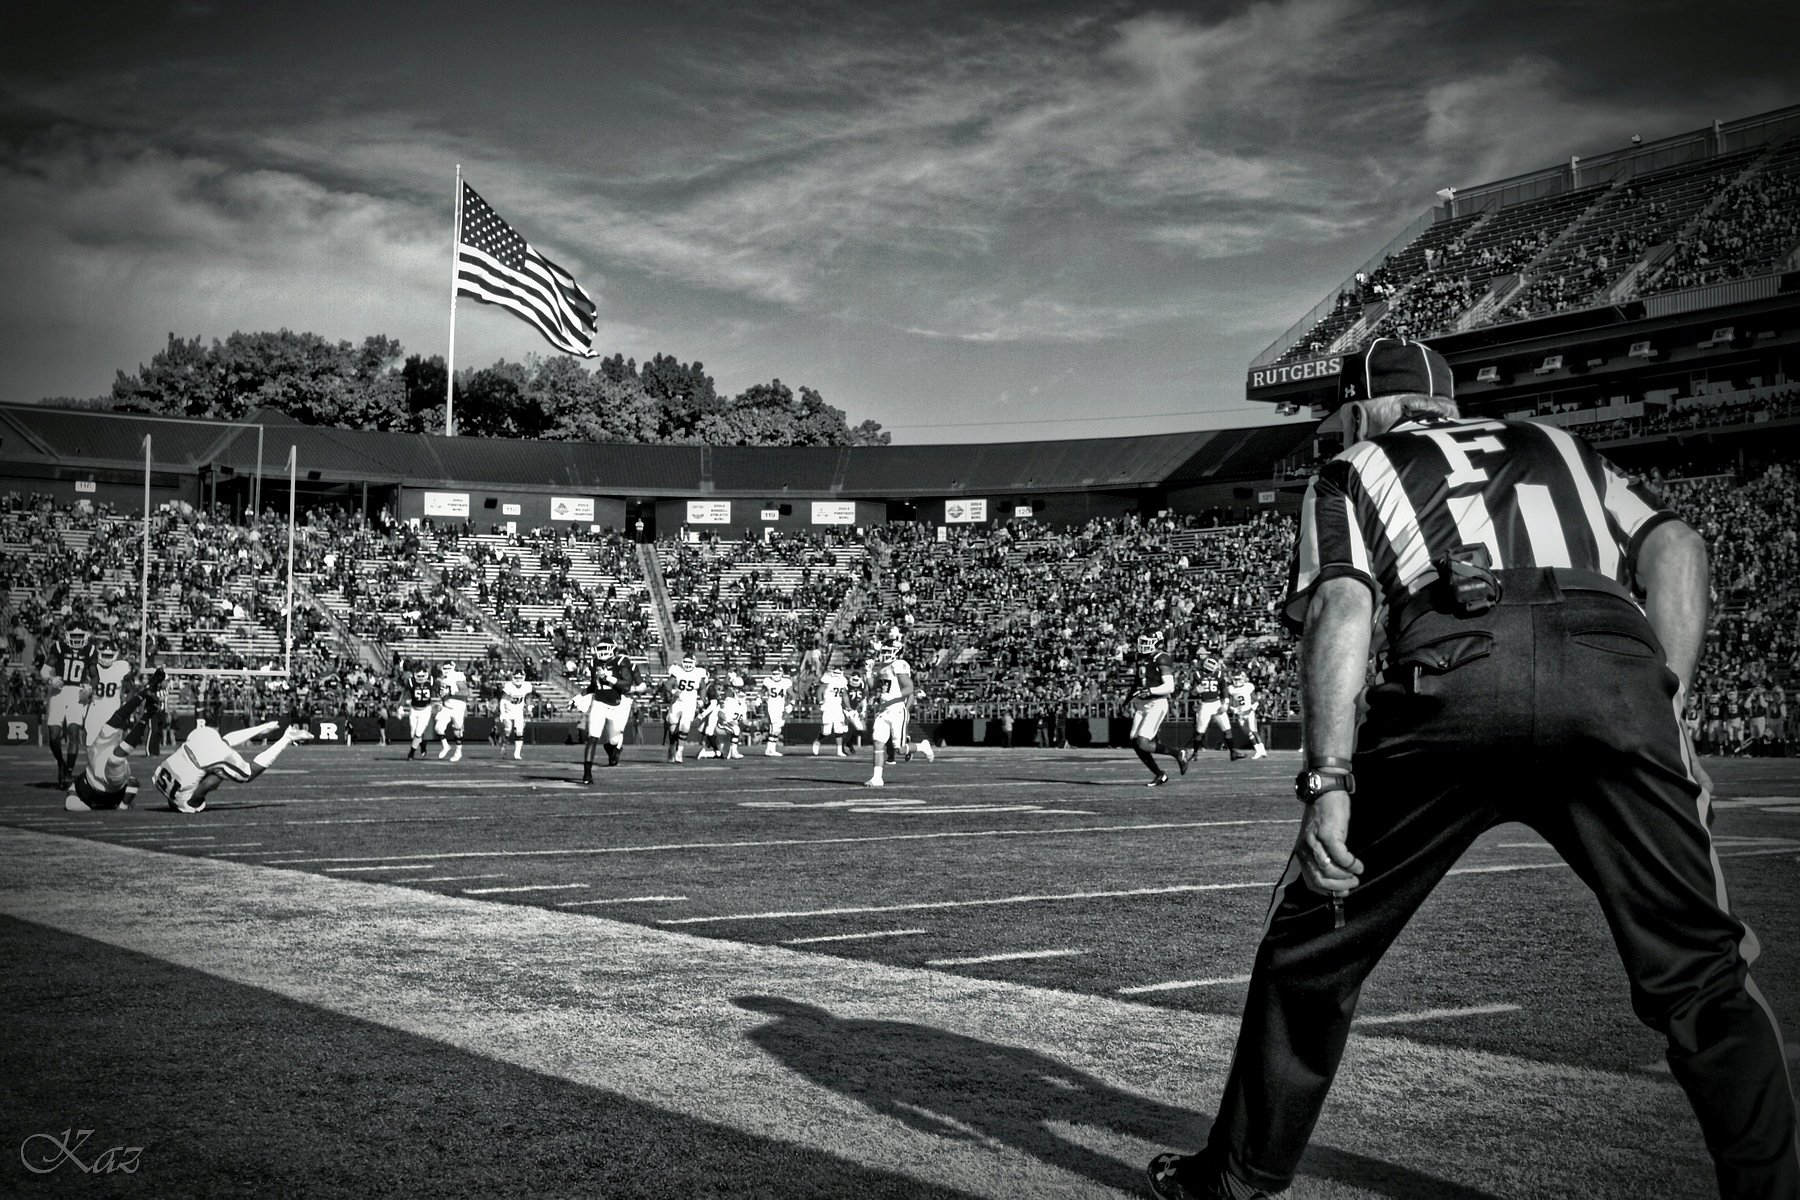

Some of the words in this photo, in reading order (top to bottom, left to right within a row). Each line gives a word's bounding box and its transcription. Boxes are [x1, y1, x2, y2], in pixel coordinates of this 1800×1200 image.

[1253, 357, 1341, 387] RUTGERS
[63, 658, 85, 682] 10
[96, 682, 117, 698] 88
[678, 679, 695, 692] 65
[770, 687, 785, 699] 54
[414, 689, 431, 701] 53
[7, 721, 29, 740] R
[319, 722, 339, 740] R
